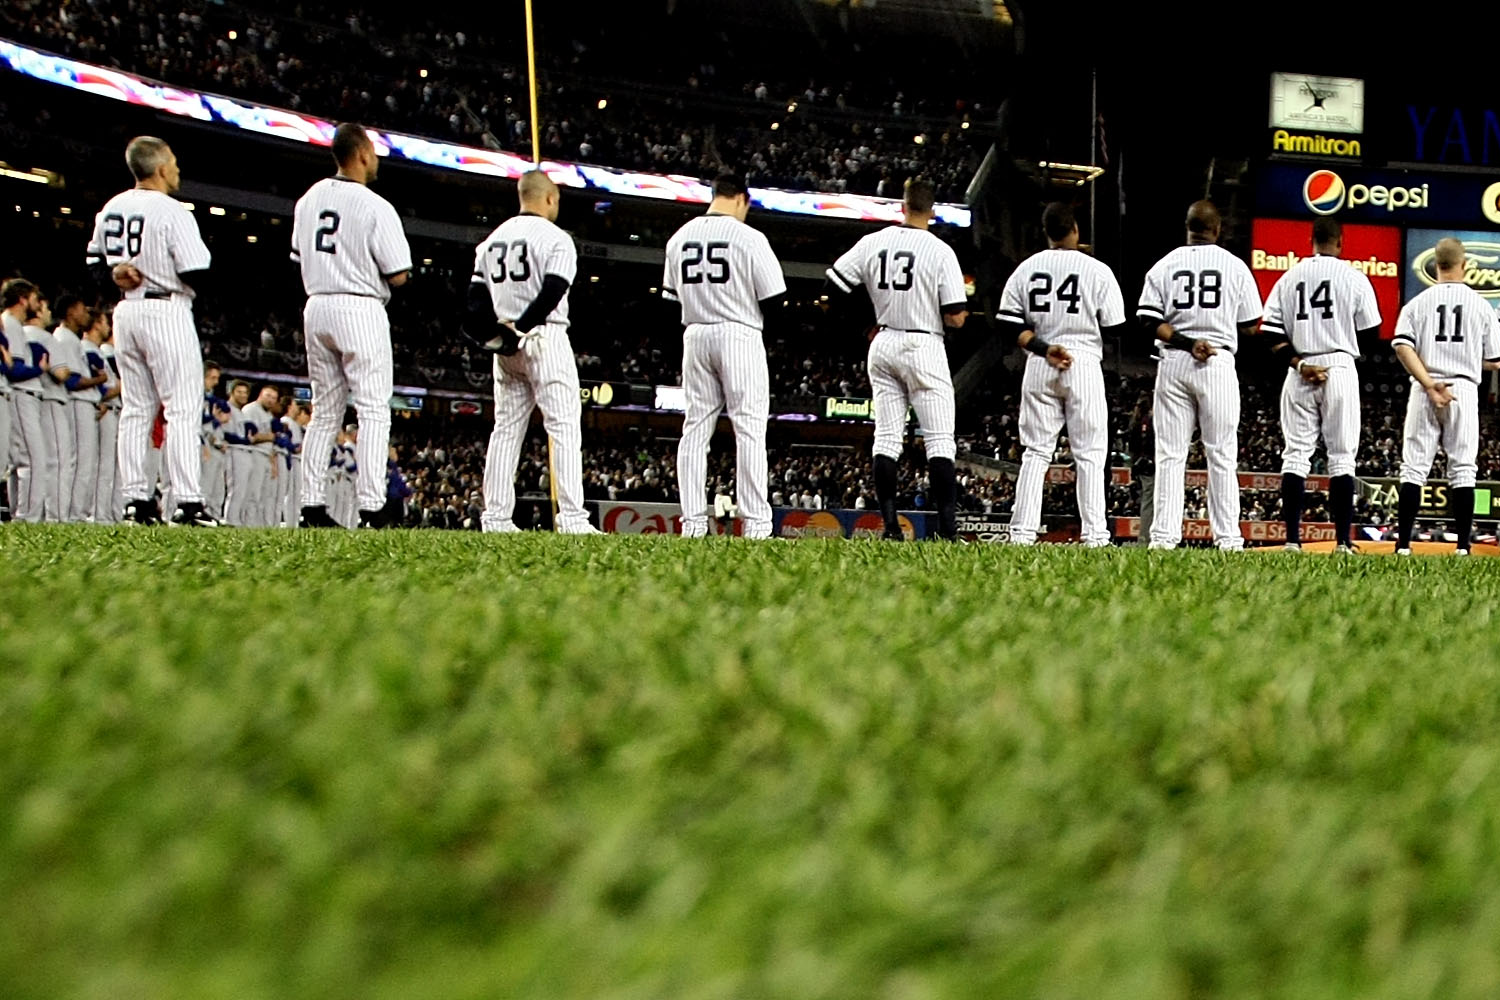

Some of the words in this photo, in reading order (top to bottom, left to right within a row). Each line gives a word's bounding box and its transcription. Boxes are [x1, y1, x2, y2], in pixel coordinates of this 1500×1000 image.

[1273, 129, 1361, 156] Armitron
[1347, 183, 1429, 211] pepsi
[104, 215, 144, 257] 28
[316, 211, 340, 254] 2
[489, 242, 530, 283] 33
[682, 243, 730, 284] 25
[878, 251, 914, 291] 13
[1029, 273, 1080, 314] 24
[1173, 270, 1221, 309] 38
[1296, 281, 1333, 320] 14
[1435, 305, 1463, 342] 11
[826, 397, 869, 418] Poland
[1371, 483, 1448, 507] ZAES
